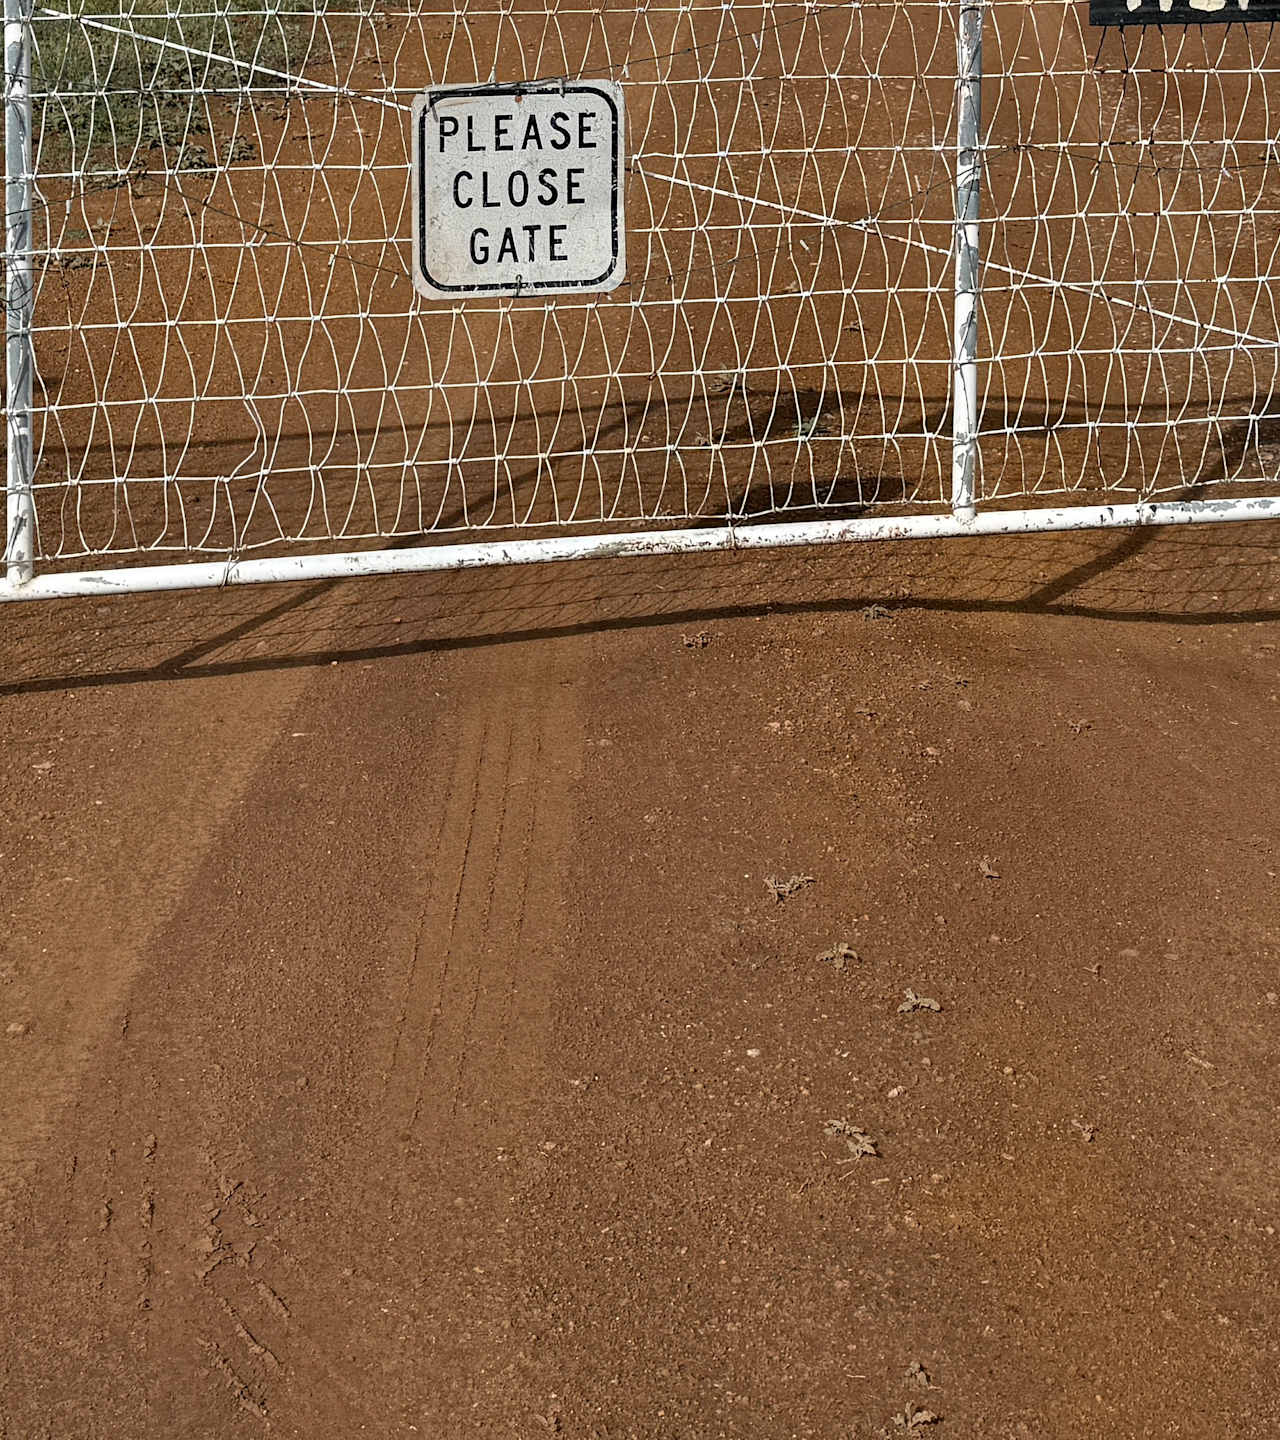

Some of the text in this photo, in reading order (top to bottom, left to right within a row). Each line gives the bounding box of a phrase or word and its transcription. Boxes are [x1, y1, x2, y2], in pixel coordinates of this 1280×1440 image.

[439, 111, 597, 153] PLEASE
[453, 167, 585, 209] CLOSE
[470, 224, 568, 265] GATE
